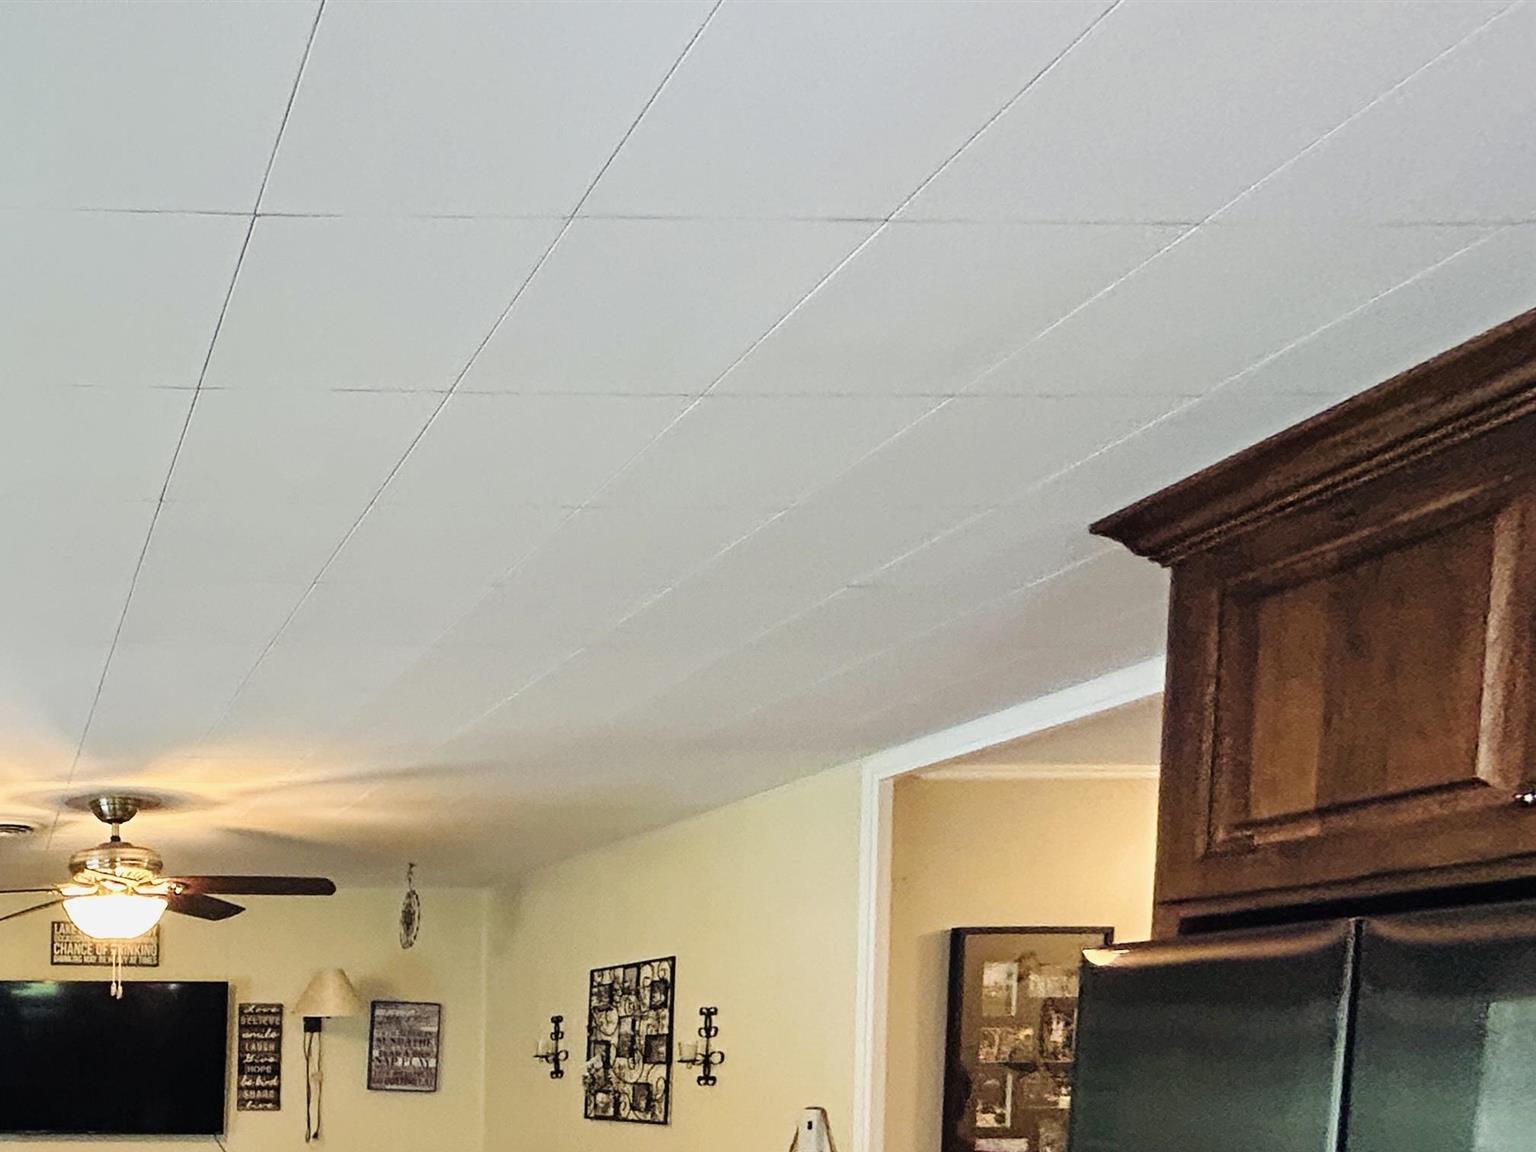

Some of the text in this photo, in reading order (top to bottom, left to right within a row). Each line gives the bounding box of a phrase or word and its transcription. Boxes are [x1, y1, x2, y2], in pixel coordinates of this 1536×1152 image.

[54, 943, 94, 955] CHANCE
[96, 944, 109, 955] OF
[247, 1065, 272, 1073] HOPE
